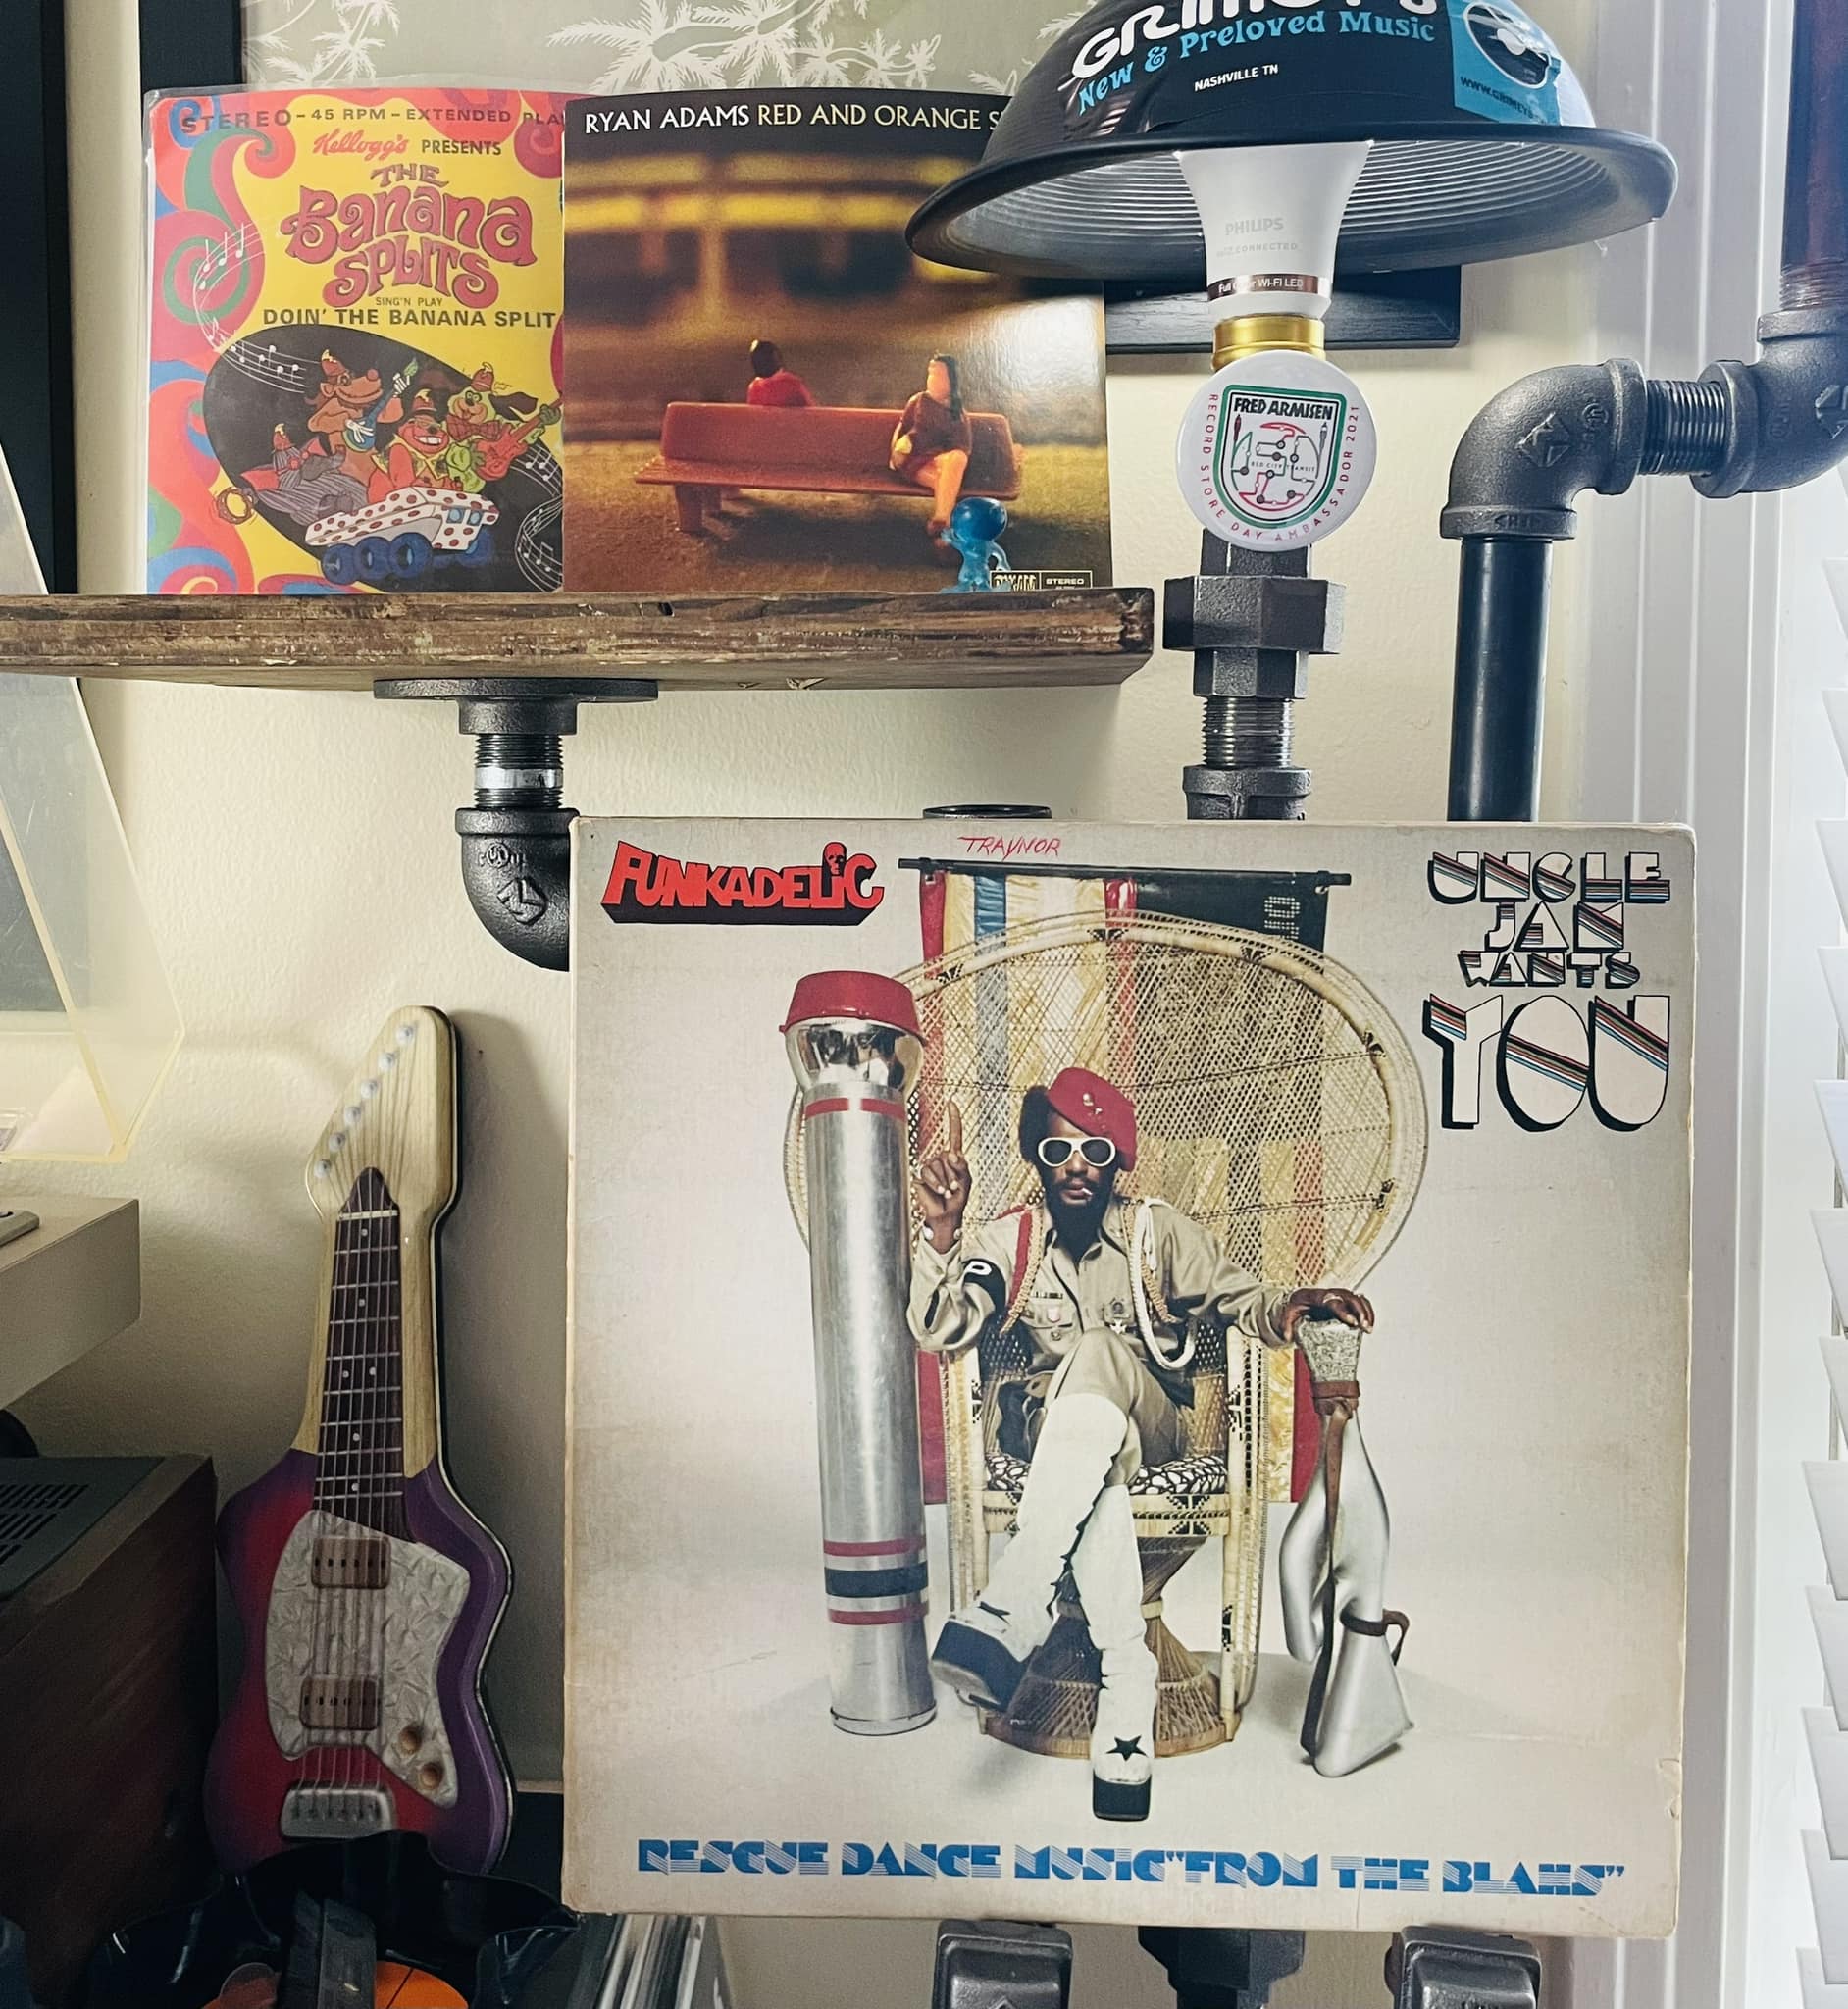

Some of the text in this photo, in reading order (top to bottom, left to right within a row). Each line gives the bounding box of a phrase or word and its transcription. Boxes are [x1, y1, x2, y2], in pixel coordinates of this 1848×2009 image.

[1078, 10, 1437, 116] New & Preloved Music
[1194, 64, 1279, 92] NASHVILLE TN
[181, 109, 292, 133] STEREO
[311, 109, 334, 121] 45
[342, 108, 386, 121] RPM
[406, 108, 511, 124] EXTENDED
[523, 111, 565, 126] PLA
[584, 108, 652, 134] RYAN
[659, 105, 750, 129] ADAMS
[757, 104, 802, 126] RED
[809, 104, 866, 127] AND
[874, 107, 982, 130] ORANGE
[312, 128, 502, 161] Kellogg's PRESENTS
[370, 162, 451, 187] THE
[1224, 217, 1284, 235] PHILIPS
[322, 234, 499, 309] SPLITS
[1284, 278, 1304, 287] LED
[417, 297, 442, 307] PLAY
[263, 307, 556, 329] DOIN' THE BANANA SPLIT
[1233, 397, 1333, 421] FRED ARMISEN
[1200, 393, 1360, 541] RECORD STORE DAY AMBASSADOR 2021
[957, 836, 1062, 861] TRAYNOR
[600, 840, 885, 926] FUNKADELIC
[1427, 850, 1670, 904] UNCLE
[1457, 950, 1641, 989] WANTS
[1422, 993, 1670, 1133] YOU
[638, 1838, 829, 1876] RESCUE
[842, 1841, 1001, 1879] DANCE
[1331, 1855, 1430, 1891] THE
[1443, 1860, 1625, 1897] BLAHS"
